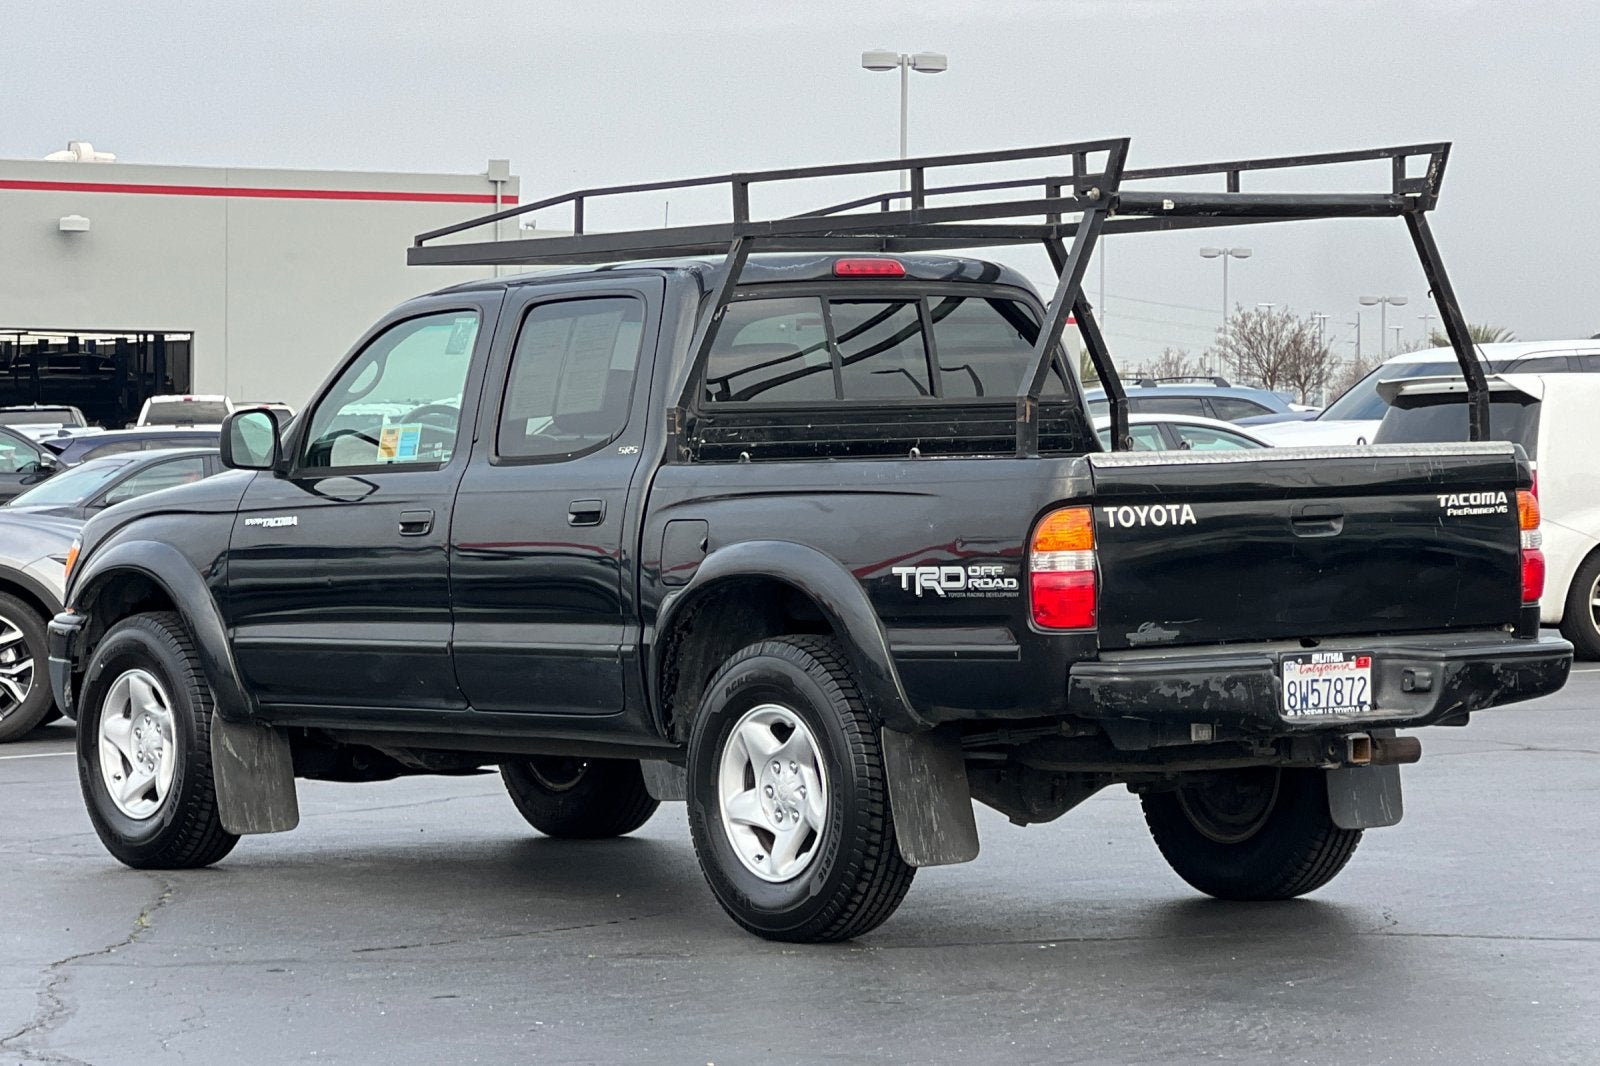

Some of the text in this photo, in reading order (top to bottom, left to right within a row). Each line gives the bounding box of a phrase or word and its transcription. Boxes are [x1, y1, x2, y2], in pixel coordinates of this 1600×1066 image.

[1437, 491, 1508, 507] TACOMA
[1103, 503, 1197, 528] TOYOTA
[1495, 505, 1508, 514] V6
[968, 566, 1005, 578] OFF
[892, 566, 967, 597] TRD
[968, 578, 1019, 590] ROAD
[1320, 652, 1344, 663] LITHIA
[1299, 663, 1355, 677] California
[1287, 676, 1368, 709] 8W57872
